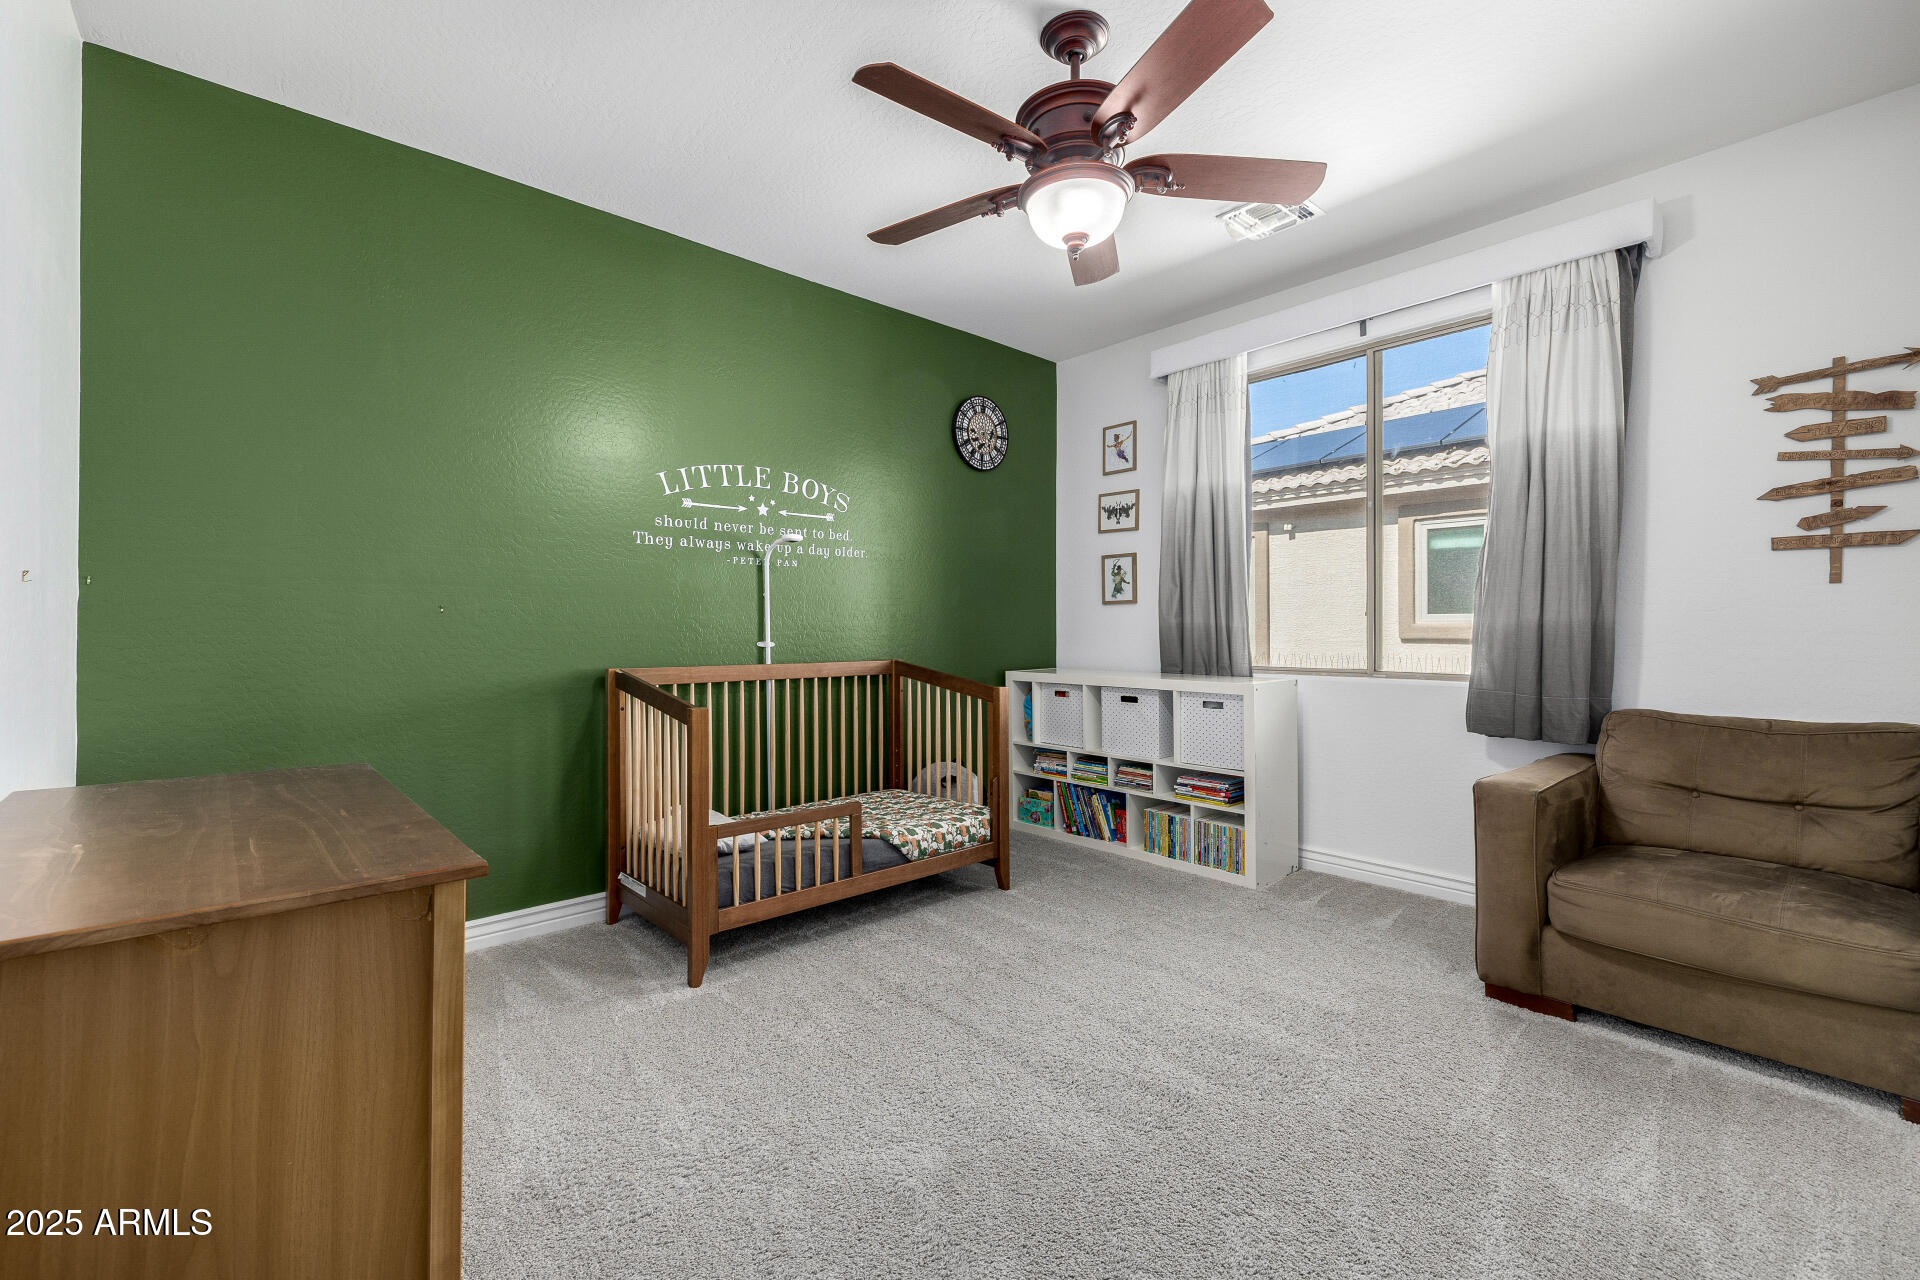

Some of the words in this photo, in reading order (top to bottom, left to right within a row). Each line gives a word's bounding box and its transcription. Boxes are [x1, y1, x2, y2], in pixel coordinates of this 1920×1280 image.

[656, 464, 771, 496] LITTLE
[782, 471, 850, 513] BOYS
[655, 514, 708, 530] should
[714, 521, 754, 534] never
[759, 523, 775, 536] be
[813, 528, 825, 540] to
[829, 528, 853, 542] bed.
[632, 530, 673, 550] They
[680, 535, 731, 553] always
[737, 540, 771, 553] wake
[776, 543, 792, 557] up
[796, 545, 804, 554] a
[808, 543, 830, 559] day
[834, 546, 868, 559] older.
[726, 556, 767, 566] -PETE
[776, 559, 798, 567] PAN
